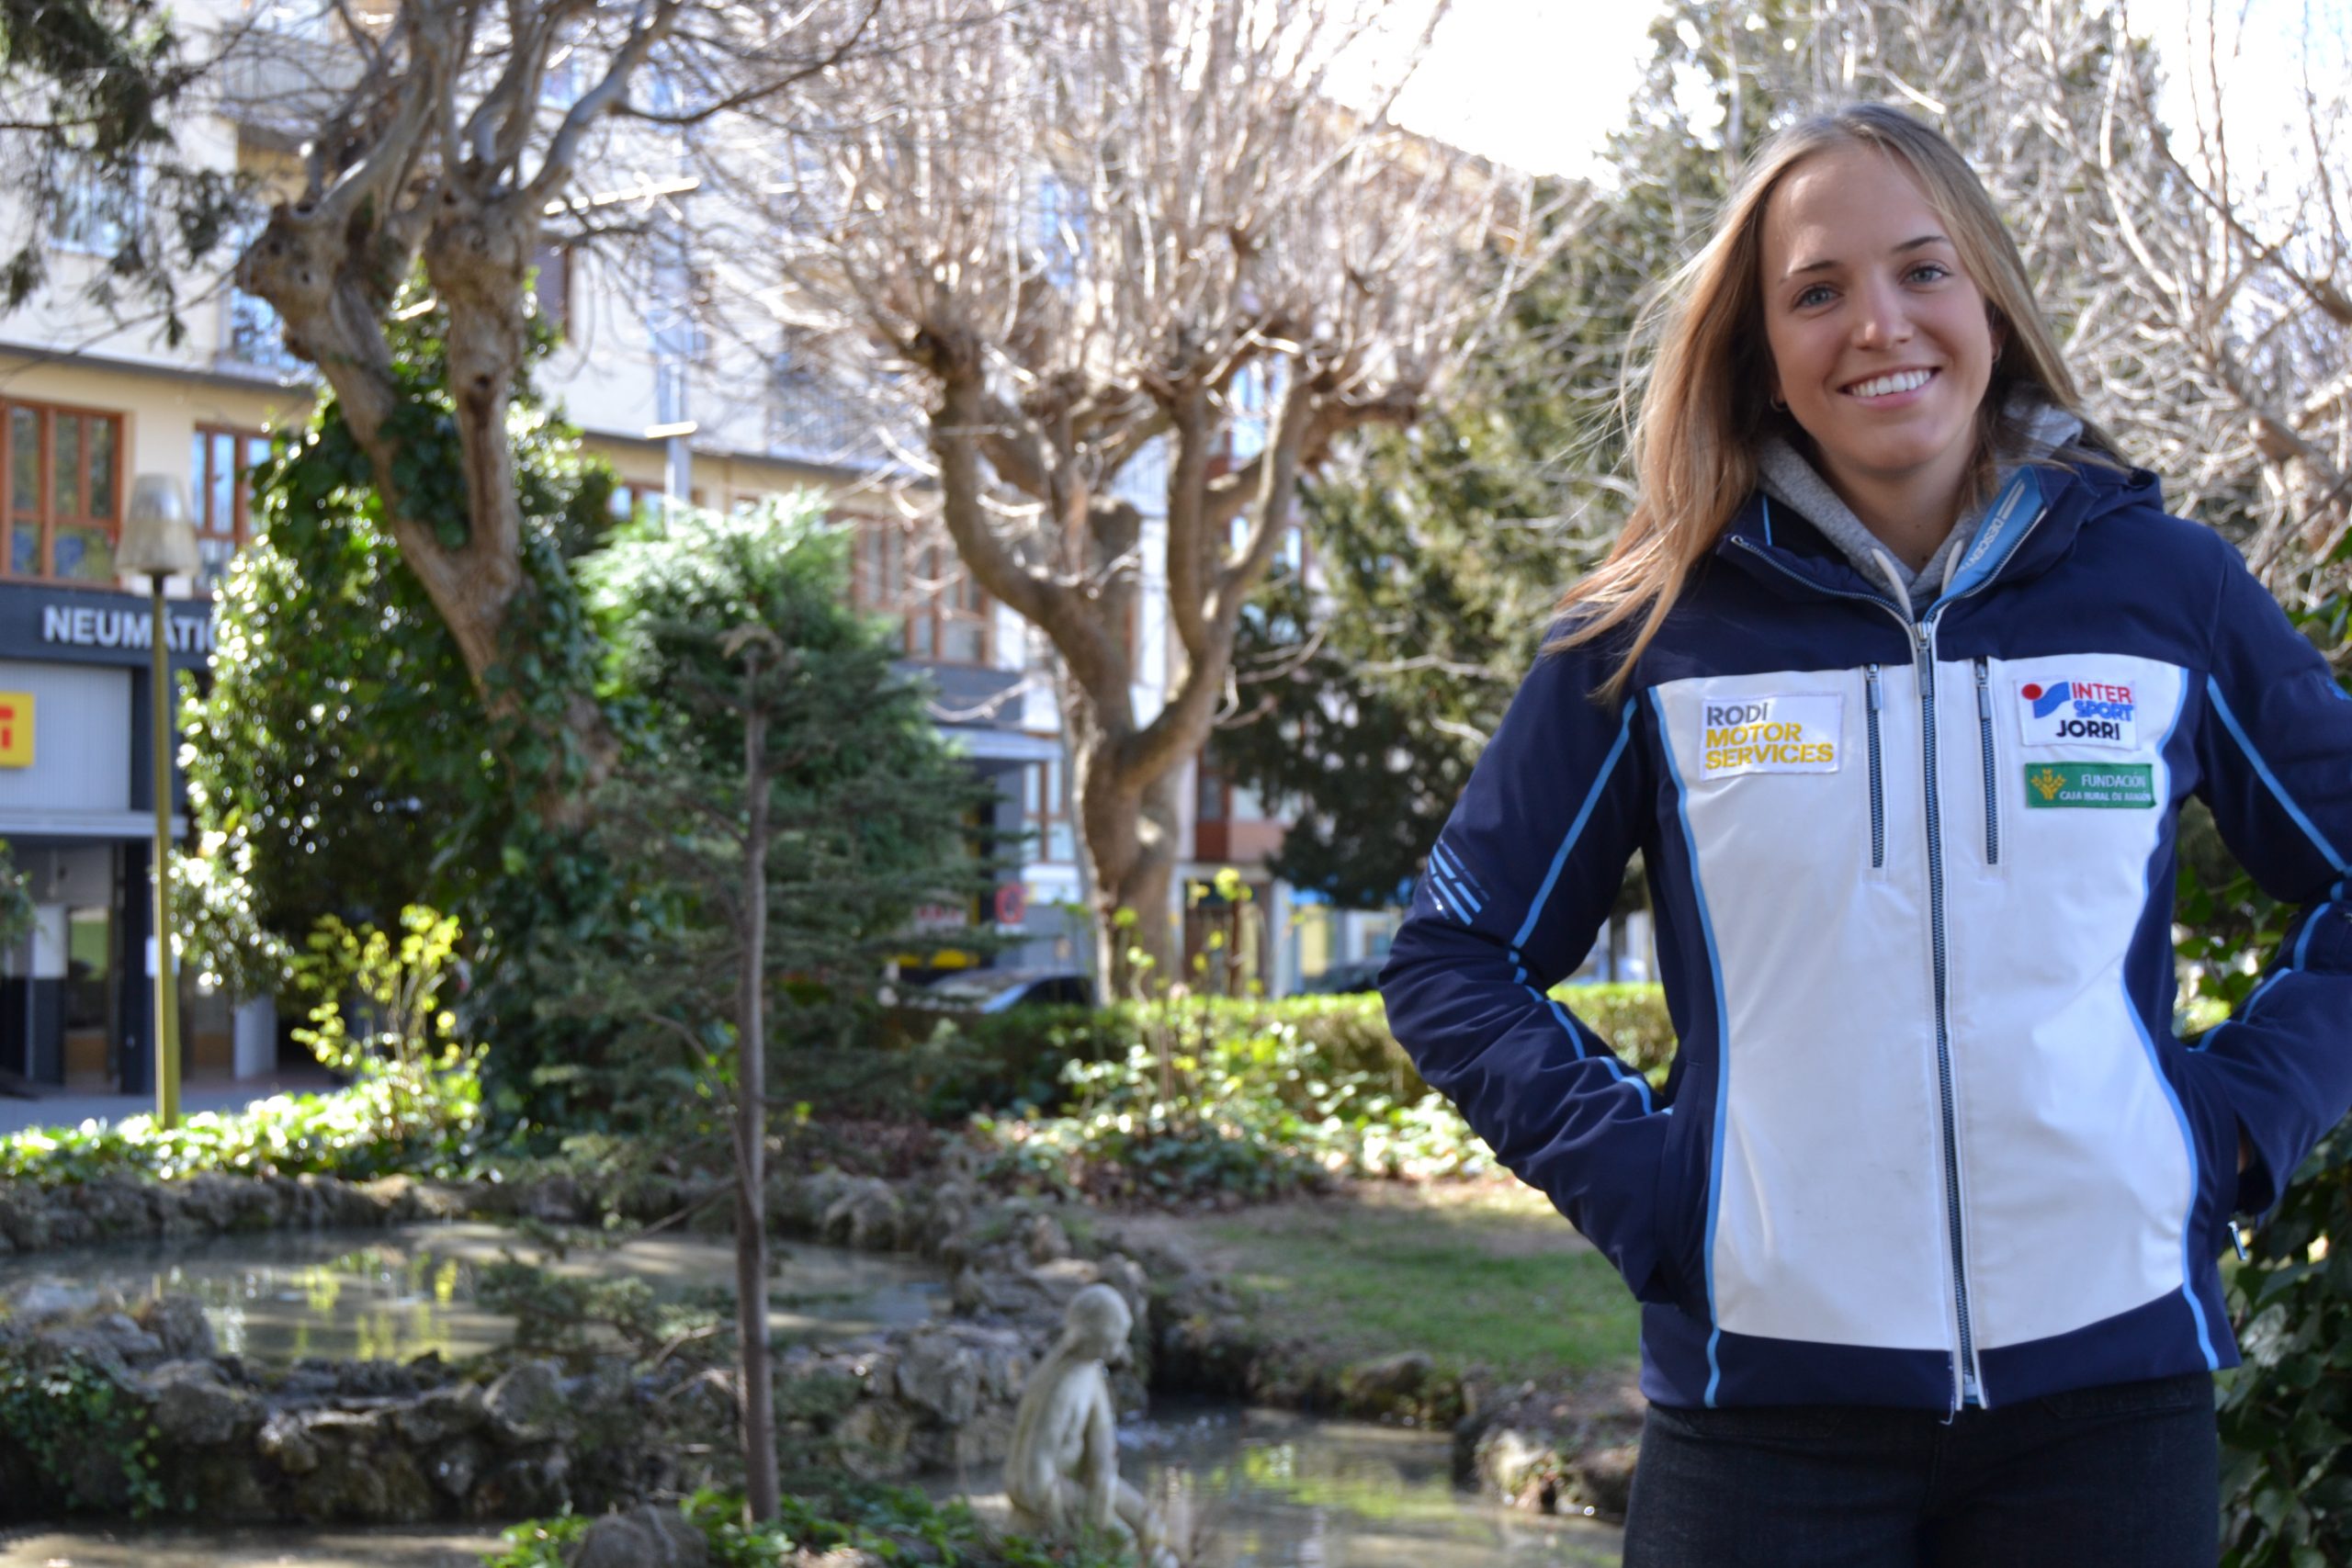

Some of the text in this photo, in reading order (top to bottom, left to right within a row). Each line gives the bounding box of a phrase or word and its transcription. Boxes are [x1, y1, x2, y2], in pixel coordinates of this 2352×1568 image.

[2072, 682, 2132, 704] INTER
[1706, 703, 1769, 727] RODI
[2073, 700, 2134, 722] SPORT
[1705, 722, 1803, 749] MOTOR
[2055, 719, 2120, 740] JORRI
[1705, 742, 1835, 770] SERVICES
[2081, 772, 2146, 787] FUNDACIÓN
[2059, 791, 2083, 801] CAJA
